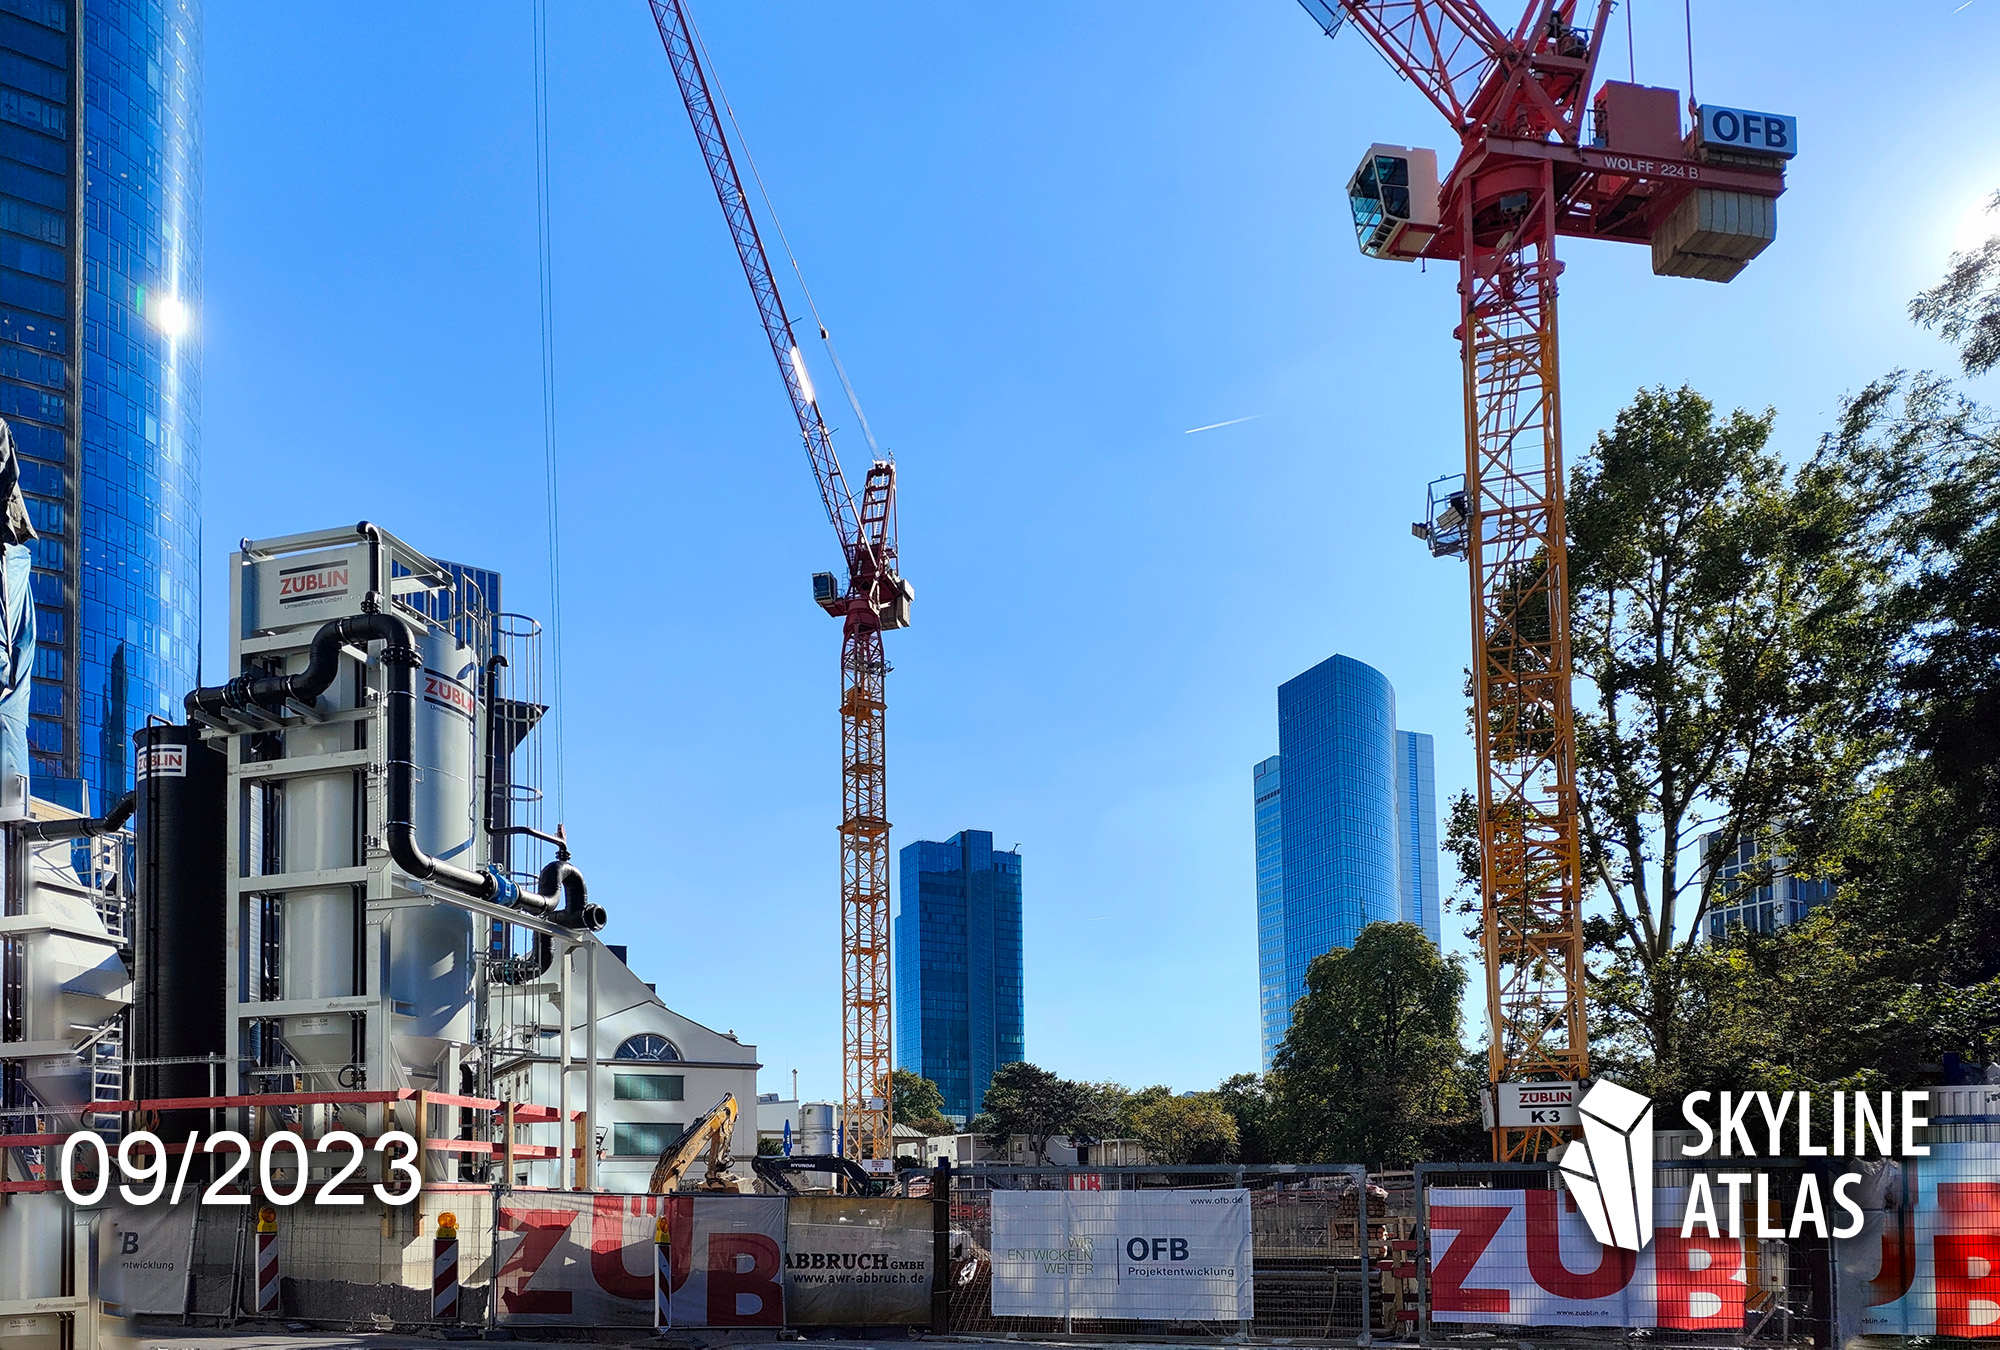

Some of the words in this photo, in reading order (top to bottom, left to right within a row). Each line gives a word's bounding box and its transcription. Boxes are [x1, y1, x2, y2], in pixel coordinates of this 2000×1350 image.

[1713, 110, 1787, 148] OFB
[1604, 156, 1654, 173] WOLFF
[1661, 164, 1685, 177] 224
[1689, 167, 1699, 179] B
[280, 569, 348, 595] ZÜBLIN
[1520, 1092, 1572, 1103] ZÜBLIN
[1189, 1196, 1243, 1204] www.ofb.de
[1067, 1236, 1094, 1248] WIR
[1007, 1249, 1094, 1261] ENTWICKELN
[1126, 1237, 1190, 1262] OFB
[890, 1261, 925, 1270] GMBH
[1043, 1263, 1094, 1275] WEITER
[793, 1273, 924, 1284] www.awr-abbruch.de
[1128, 1267, 1235, 1278] Projektentwicklung
